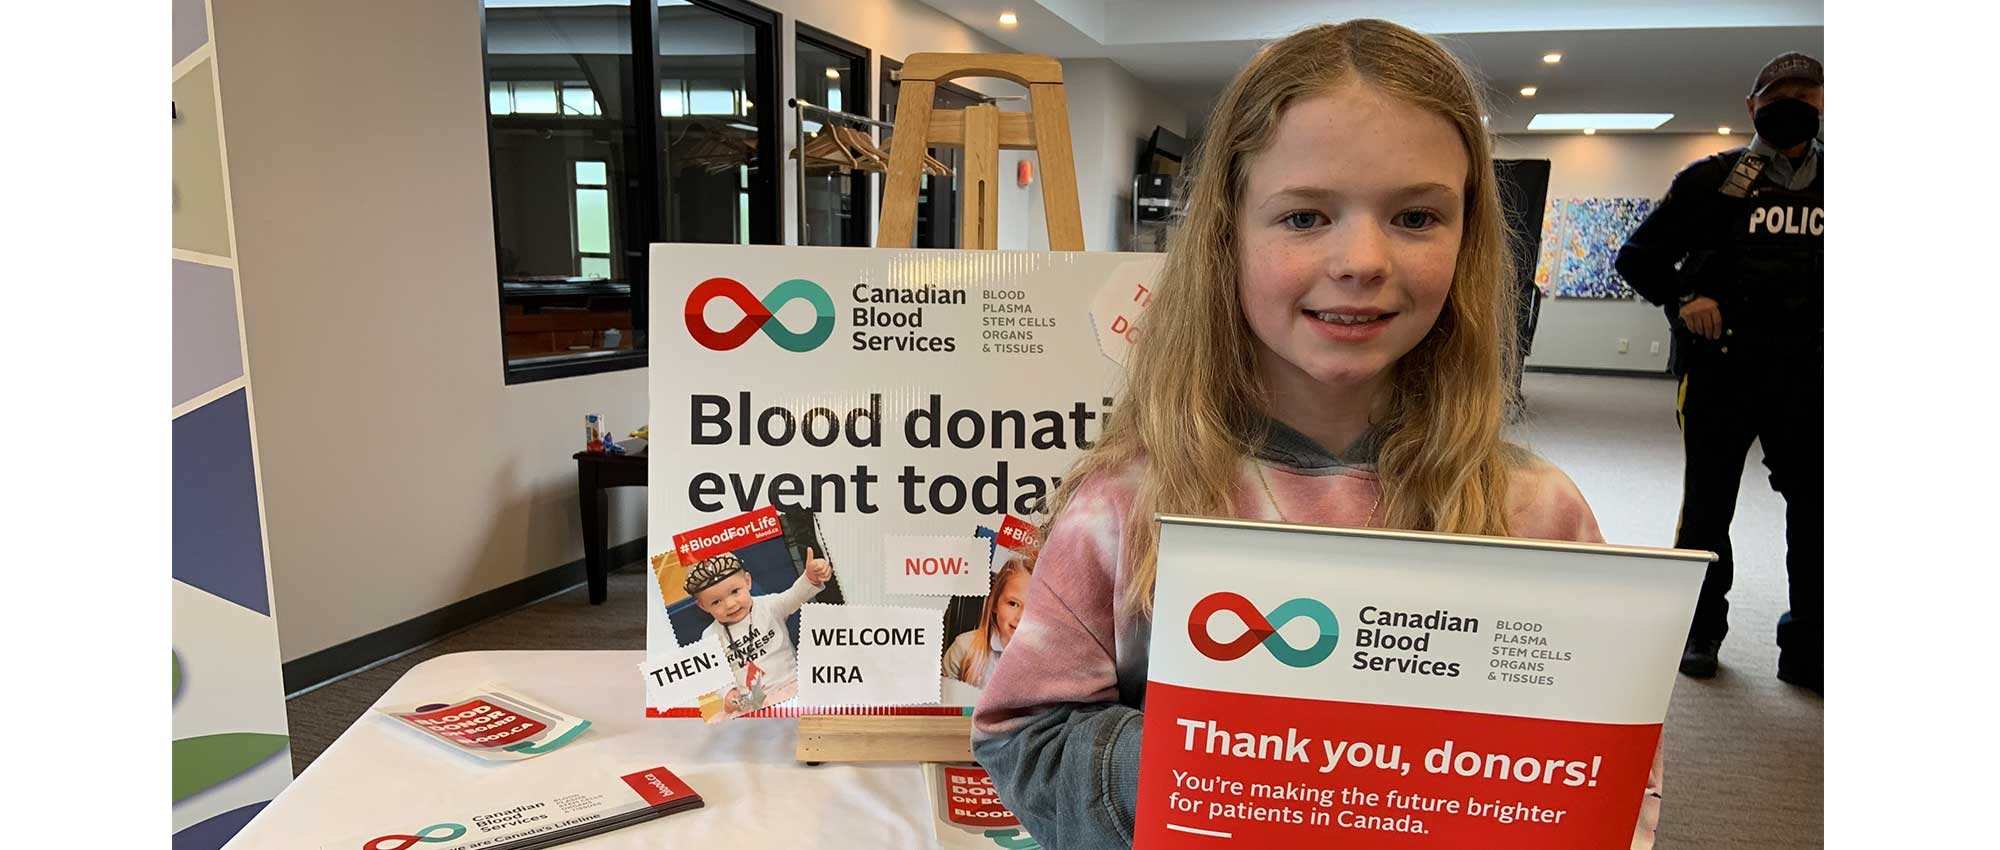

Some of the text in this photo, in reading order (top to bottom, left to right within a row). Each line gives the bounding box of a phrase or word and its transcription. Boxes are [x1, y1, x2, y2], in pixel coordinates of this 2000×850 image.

[852, 283, 967, 305] Canadian
[982, 289, 1025, 300] BLOOD
[852, 306, 923, 328] Blood
[982, 303, 1033, 314] PLASMA
[982, 317, 1056, 328] STEM CELLS
[852, 330, 956, 352] Services
[982, 330, 1034, 341] ORGANS
[982, 343, 1044, 354] & TISSUES
[690, 391, 882, 448] Blood
[688, 464, 881, 514] event
[680, 516, 777, 554] #BloodForLife
[905, 557, 969, 576] NOW:
[1358, 605, 1479, 633] Canadian
[1495, 620, 1543, 633] BLOOD
[811, 628, 925, 646] WELCOME
[1355, 628, 1430, 652] Blood
[1493, 633, 1548, 646] PLASMA
[1491, 645, 1572, 661] STEM CELLS
[650, 653, 719, 687] THEN:
[1352, 651, 1460, 677] Services
[1489, 659, 1545, 672] ORGANS
[811, 665, 864, 683] KIRA
[1487, 671, 1555, 686] & TISSUES
[1176, 717, 1602, 787] Thank you, donors!
[952, 796, 978, 804] ON
[1171, 769, 1567, 824] You’re making the future brighter
[472, 802, 545, 822] Canadian
[476, 813, 523, 828] Blood
[1169, 791, 1429, 834] for patients in Canada.
[470, 840, 491, 848] are
[554, 813, 600, 830] Lifeline
[480, 814, 549, 832] Services
